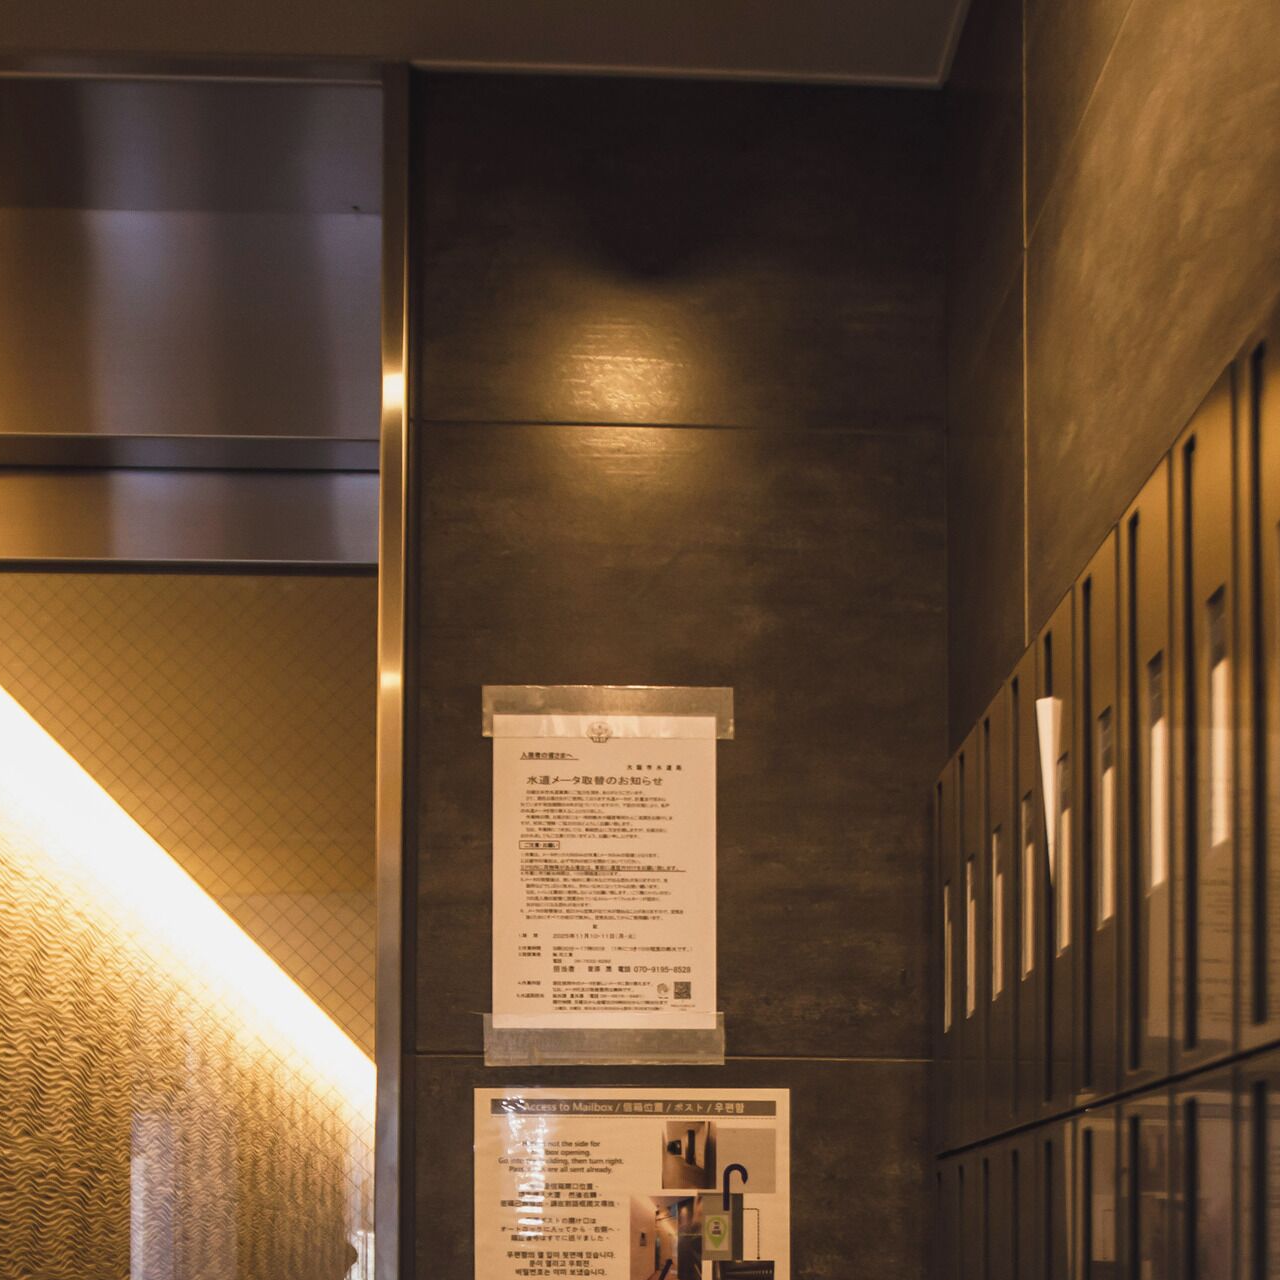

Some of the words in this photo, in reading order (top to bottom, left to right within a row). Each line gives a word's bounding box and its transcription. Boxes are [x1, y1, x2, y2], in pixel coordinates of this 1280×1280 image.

[526, 775, 664, 786] 水道メータ取替のお知らせ
[524, 1101, 557, 1112] Access
[559, 1102, 570, 1112] to
[573, 1101, 613, 1112] Mailbox
